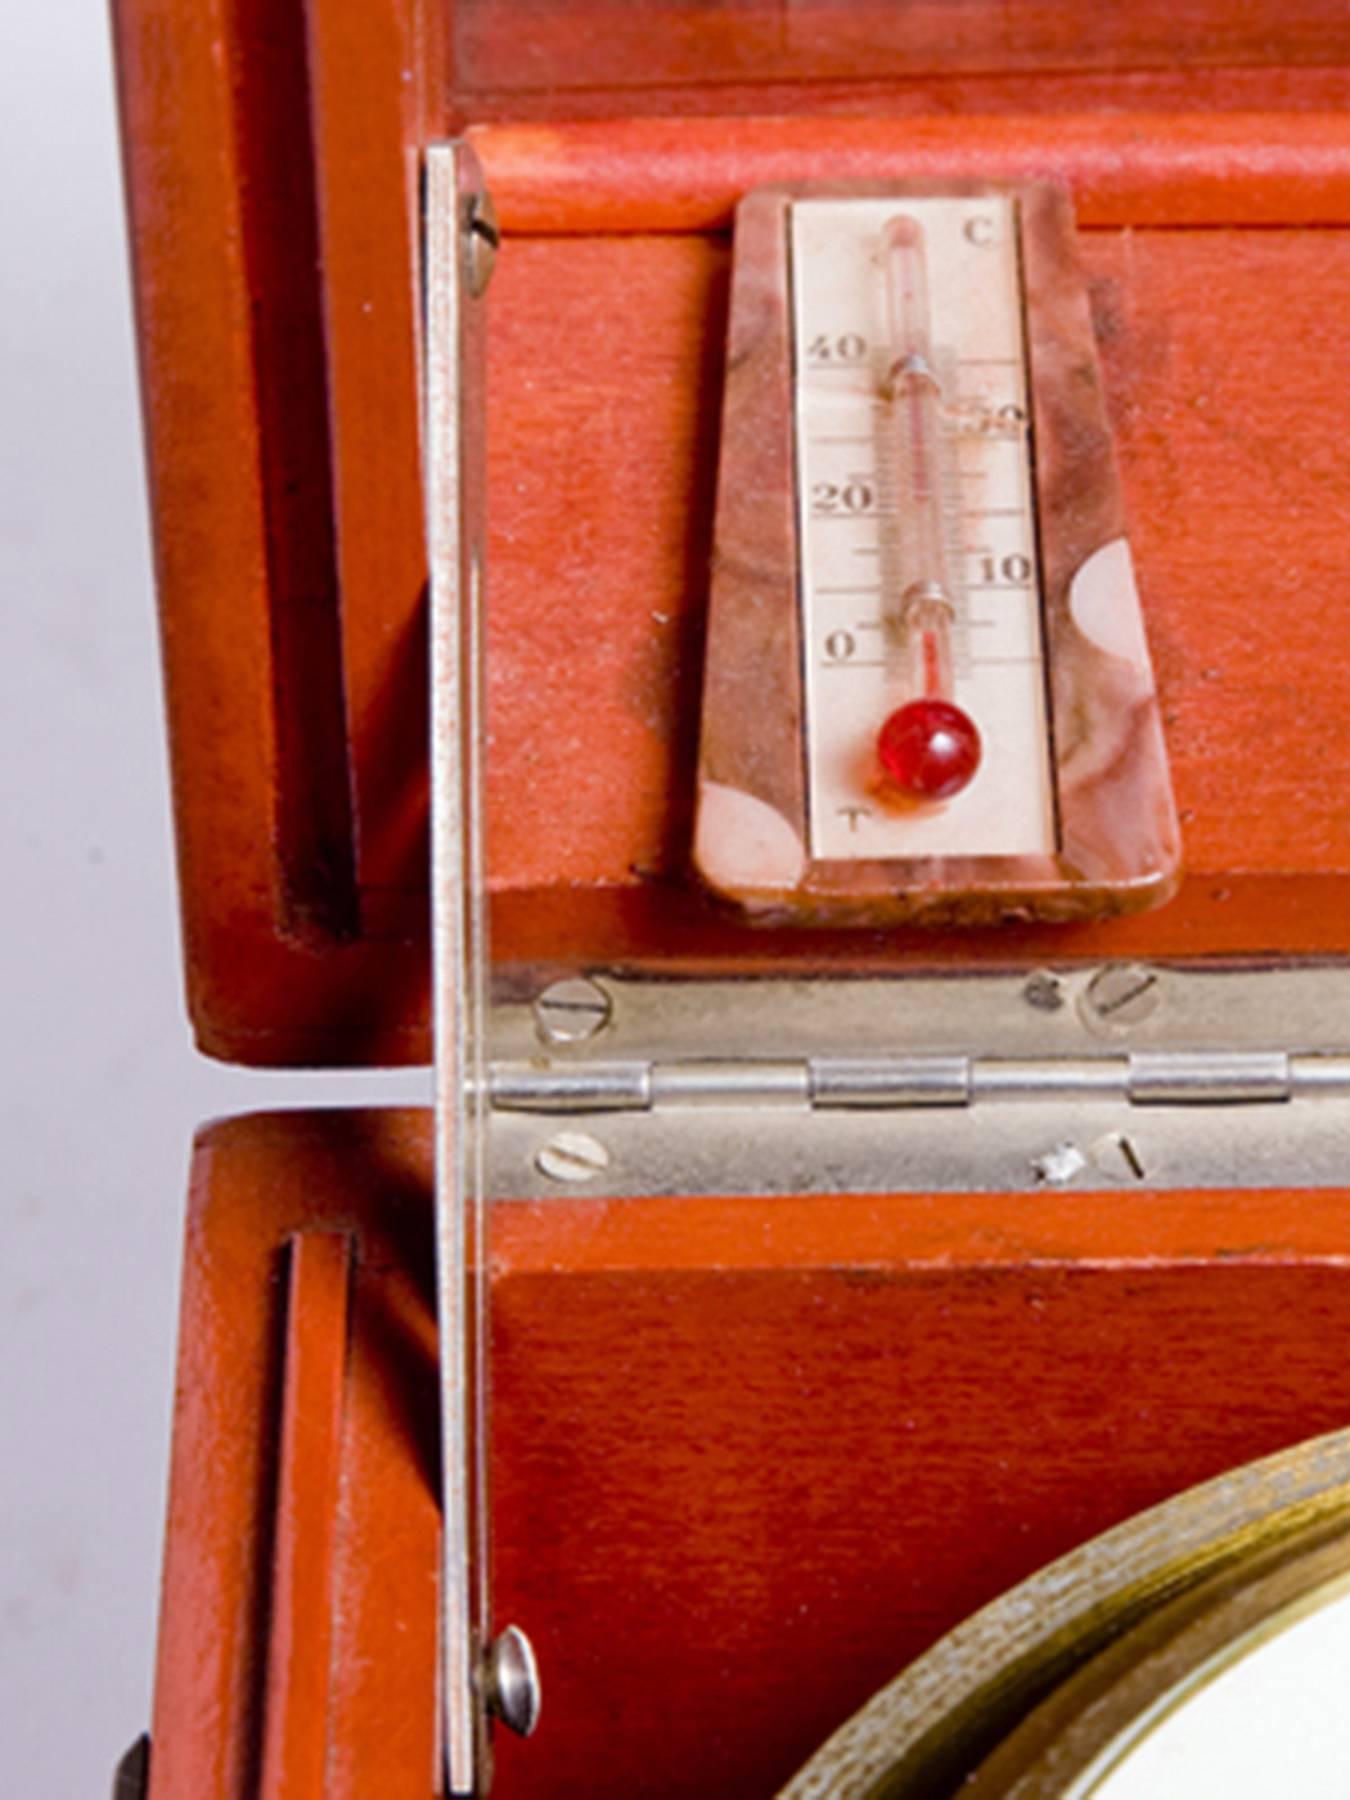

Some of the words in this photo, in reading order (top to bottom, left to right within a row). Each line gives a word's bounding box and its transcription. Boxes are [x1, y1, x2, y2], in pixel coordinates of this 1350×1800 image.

[963, 217, 993, 246] C
[807, 332, 868, 360] 40
[811, 483, 873, 511] 20
[981, 553, 1031, 583] 10
[824, 630, 856, 659] 0
